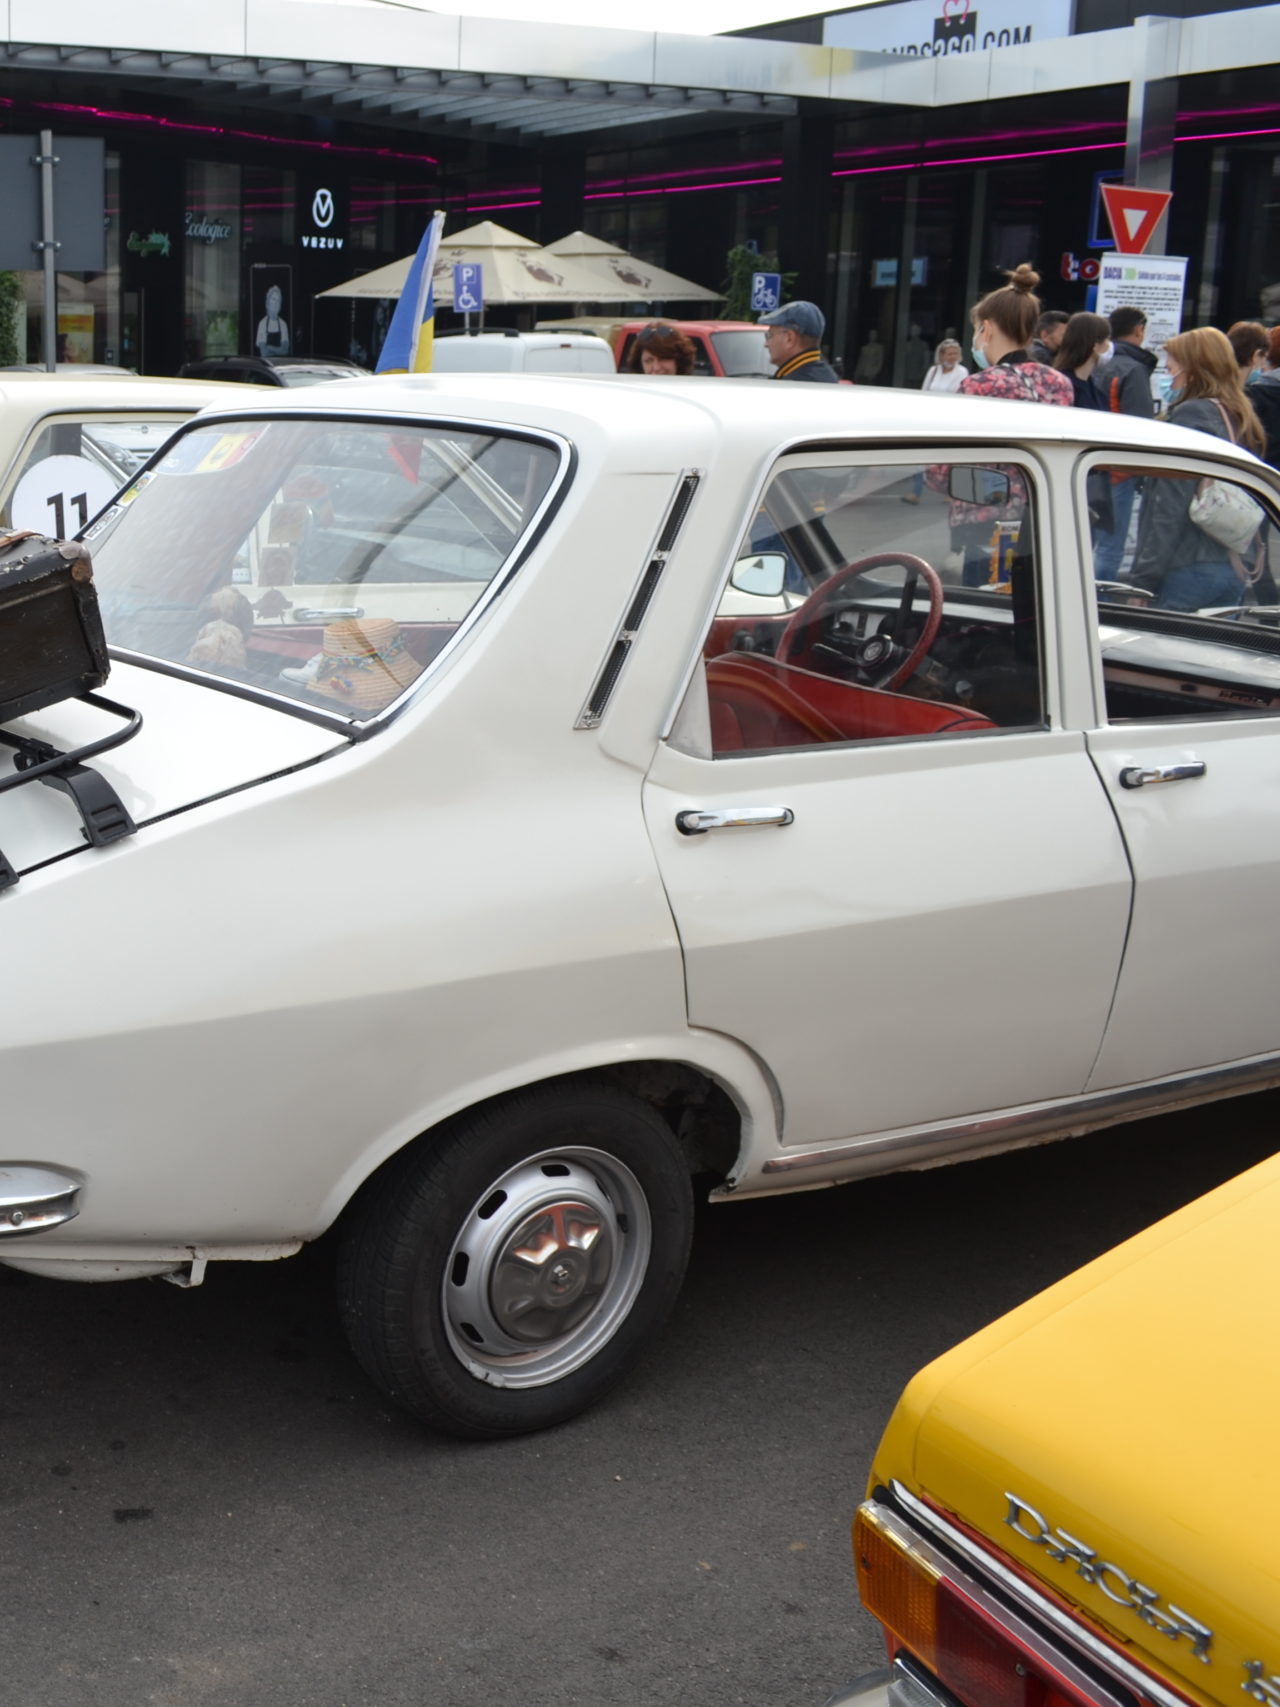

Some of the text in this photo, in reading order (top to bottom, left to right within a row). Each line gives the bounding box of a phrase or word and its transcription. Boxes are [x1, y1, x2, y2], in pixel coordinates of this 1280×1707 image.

[302, 236, 343, 249] VEZUV
[463, 268, 473, 282] P
[754, 276, 766, 293] P
[46, 491, 89, 541] 11
[1003, 1491, 1213, 1664] DACIA
